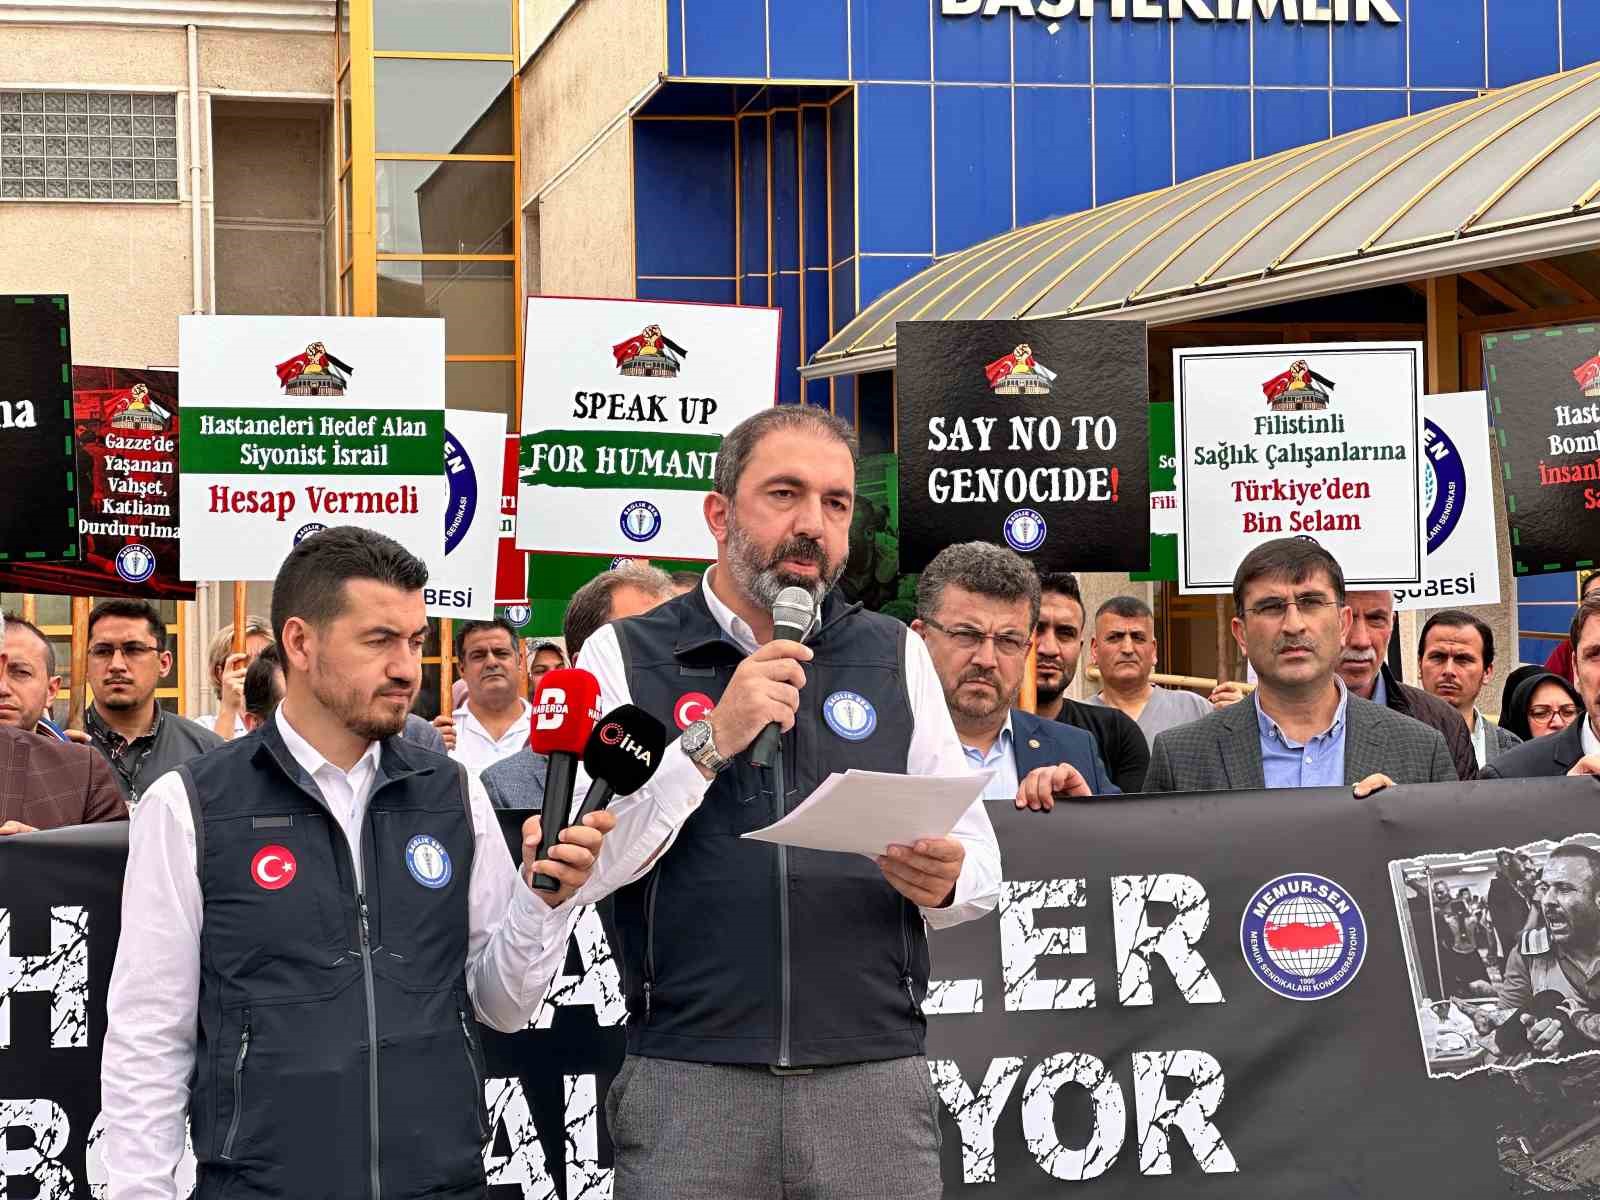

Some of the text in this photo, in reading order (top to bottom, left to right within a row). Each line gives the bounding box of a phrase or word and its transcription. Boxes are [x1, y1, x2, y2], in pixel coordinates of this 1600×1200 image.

[573, 391, 718, 424] SPEAK UP
[1554, 403, 1600, 426] Hast
[200, 416, 427, 437] Hastaneleri Hedef Alan
[928, 415, 1117, 451] SAY NO TO
[1254, 413, 1344, 436] Filistinli
[105, 433, 175, 452] Gazze'de
[240, 440, 388, 470] Siyonist İsrail
[1194, 440, 1406, 470] Sağlık Çalışanlarına
[104, 455, 173, 475] Yaşanan
[530, 443, 587, 474] FOR
[108, 478, 167, 498] Vahşet,
[928, 464, 1119, 503] GENOCIDE!
[1231, 477, 1370, 508] Türkiye'den
[102, 498, 170, 517] Katliam
[209, 485, 419, 521] Hesap Vermeli
[1243, 509, 1361, 535] Bin Selam
[1252, 880, 1351, 919] MEMUR-SEN
